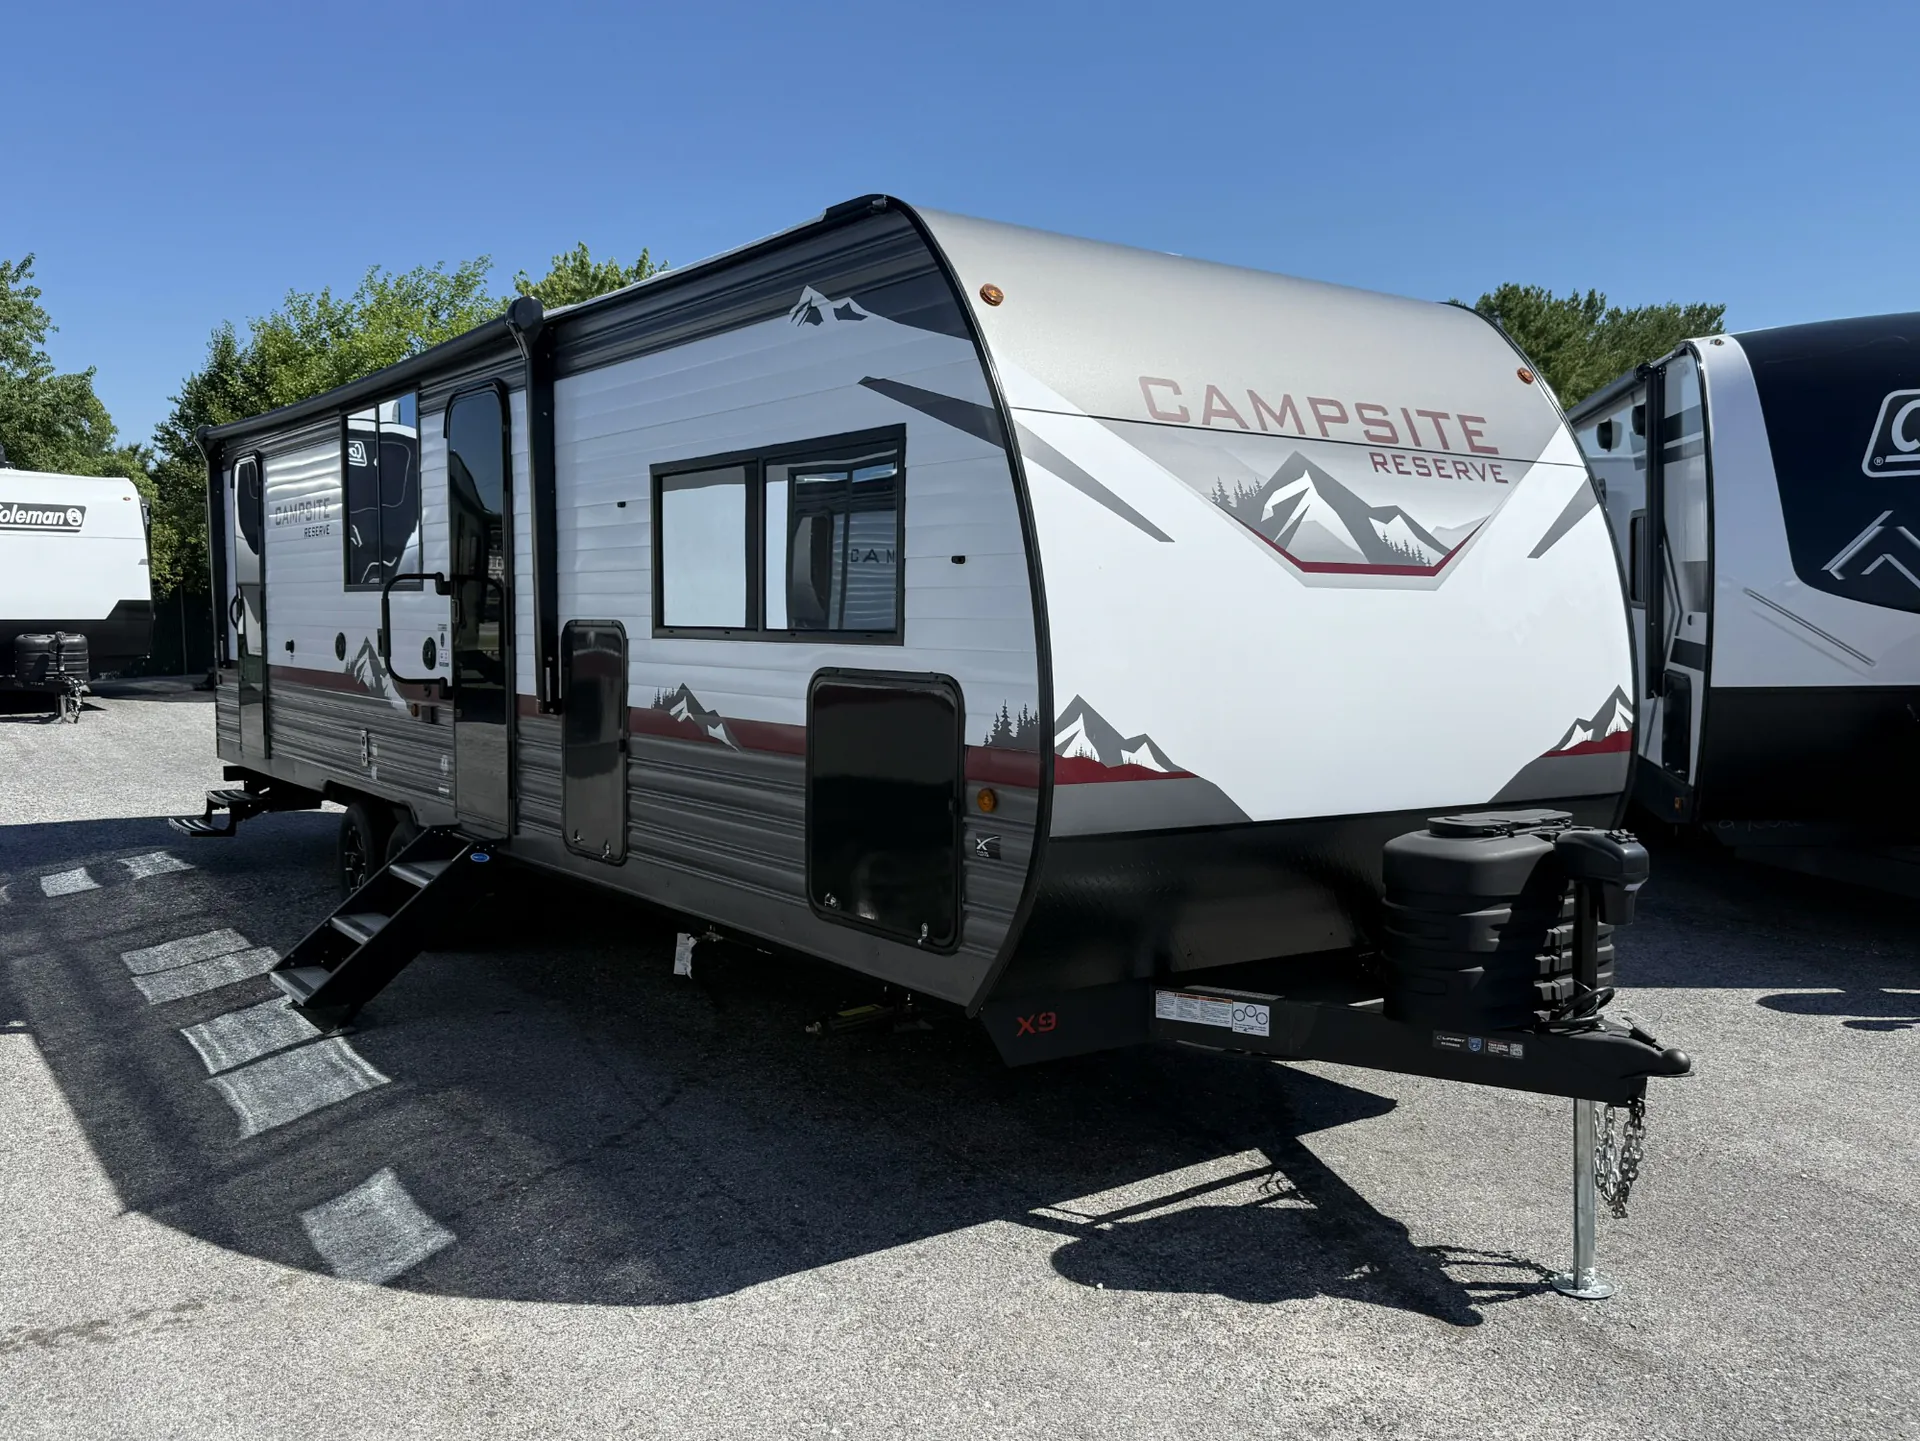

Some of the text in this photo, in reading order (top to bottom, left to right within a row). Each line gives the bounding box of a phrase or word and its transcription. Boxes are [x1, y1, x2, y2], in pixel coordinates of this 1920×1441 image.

[1138, 376, 1500, 455] CAMPSITE
[1369, 452, 1509, 484] RESERVE
[0, 504, 65, 525] oleman
[275, 497, 330, 526] CAMPSITE
[304, 524, 330, 538] RESERVE
[1016, 1011, 1056, 1037] X9
